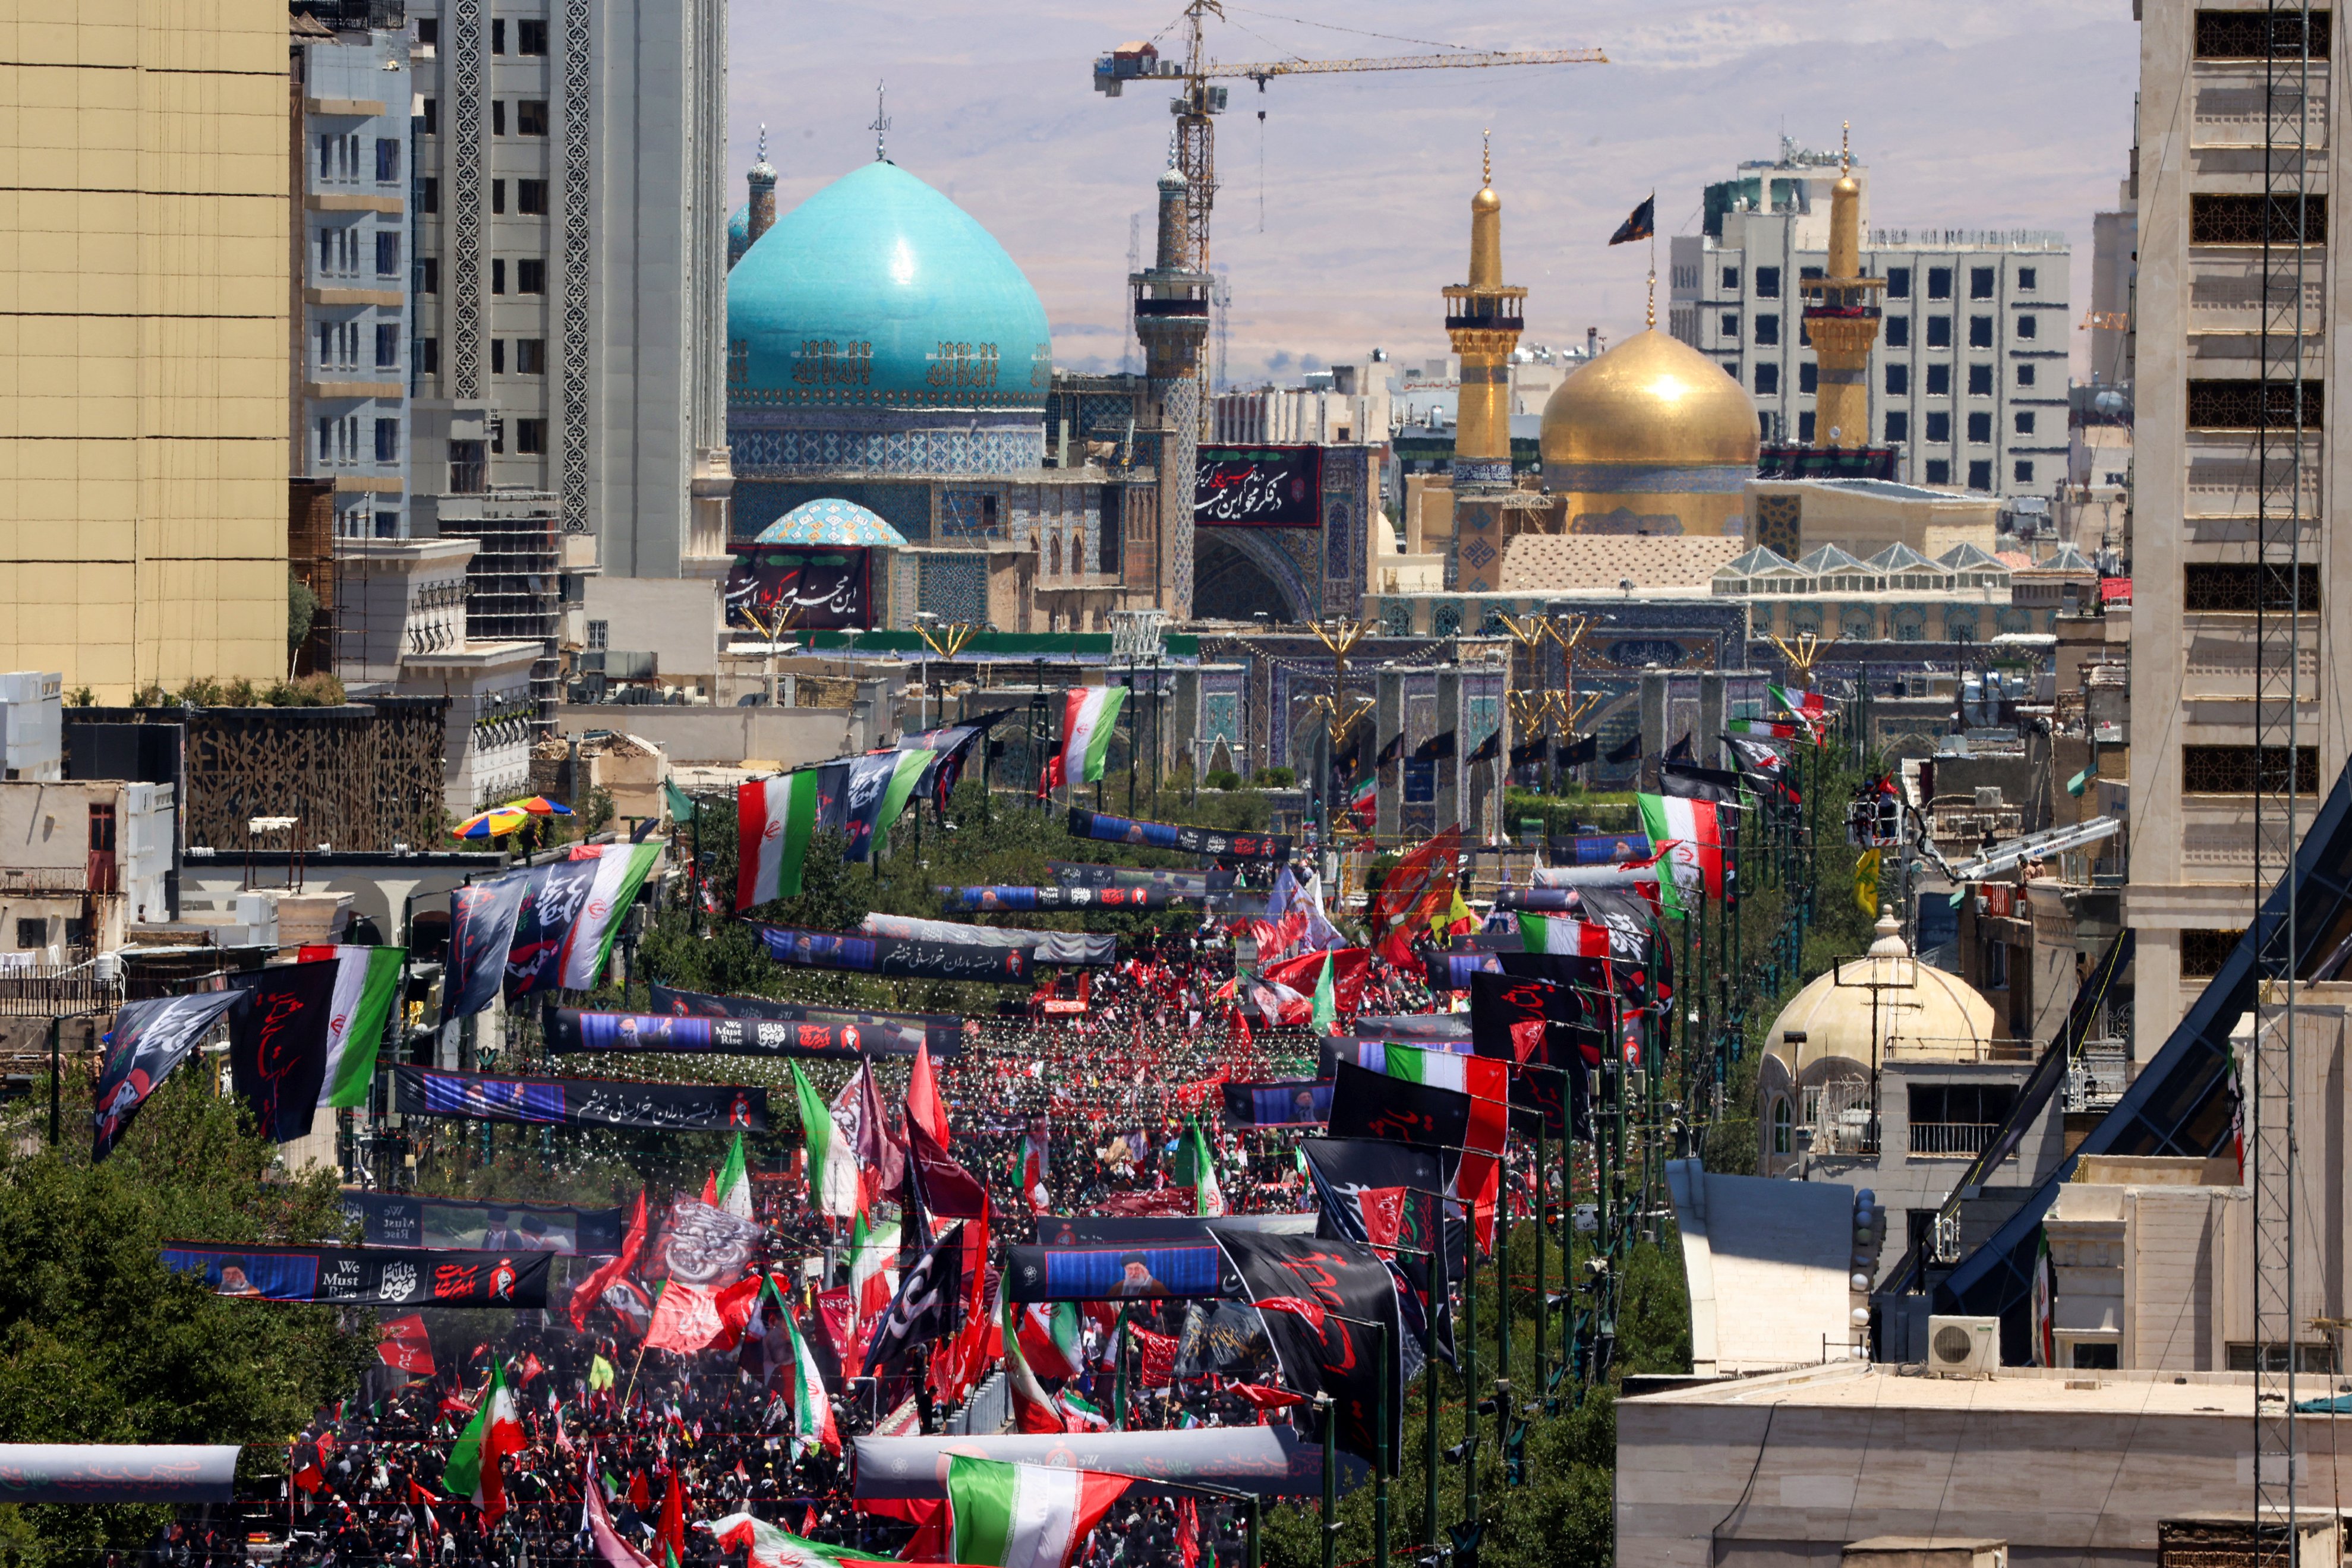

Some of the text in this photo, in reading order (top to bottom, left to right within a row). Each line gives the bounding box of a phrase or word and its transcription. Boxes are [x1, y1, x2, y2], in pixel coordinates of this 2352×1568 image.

[715, 1027, 743, 1036] Must
[721, 1036, 743, 1046] Rise
[608, 1094, 652, 1123] خراسانی
[338, 1260, 360, 1274] We
[322, 1273, 358, 1286] Must
[328, 1286, 357, 1298] Rise
